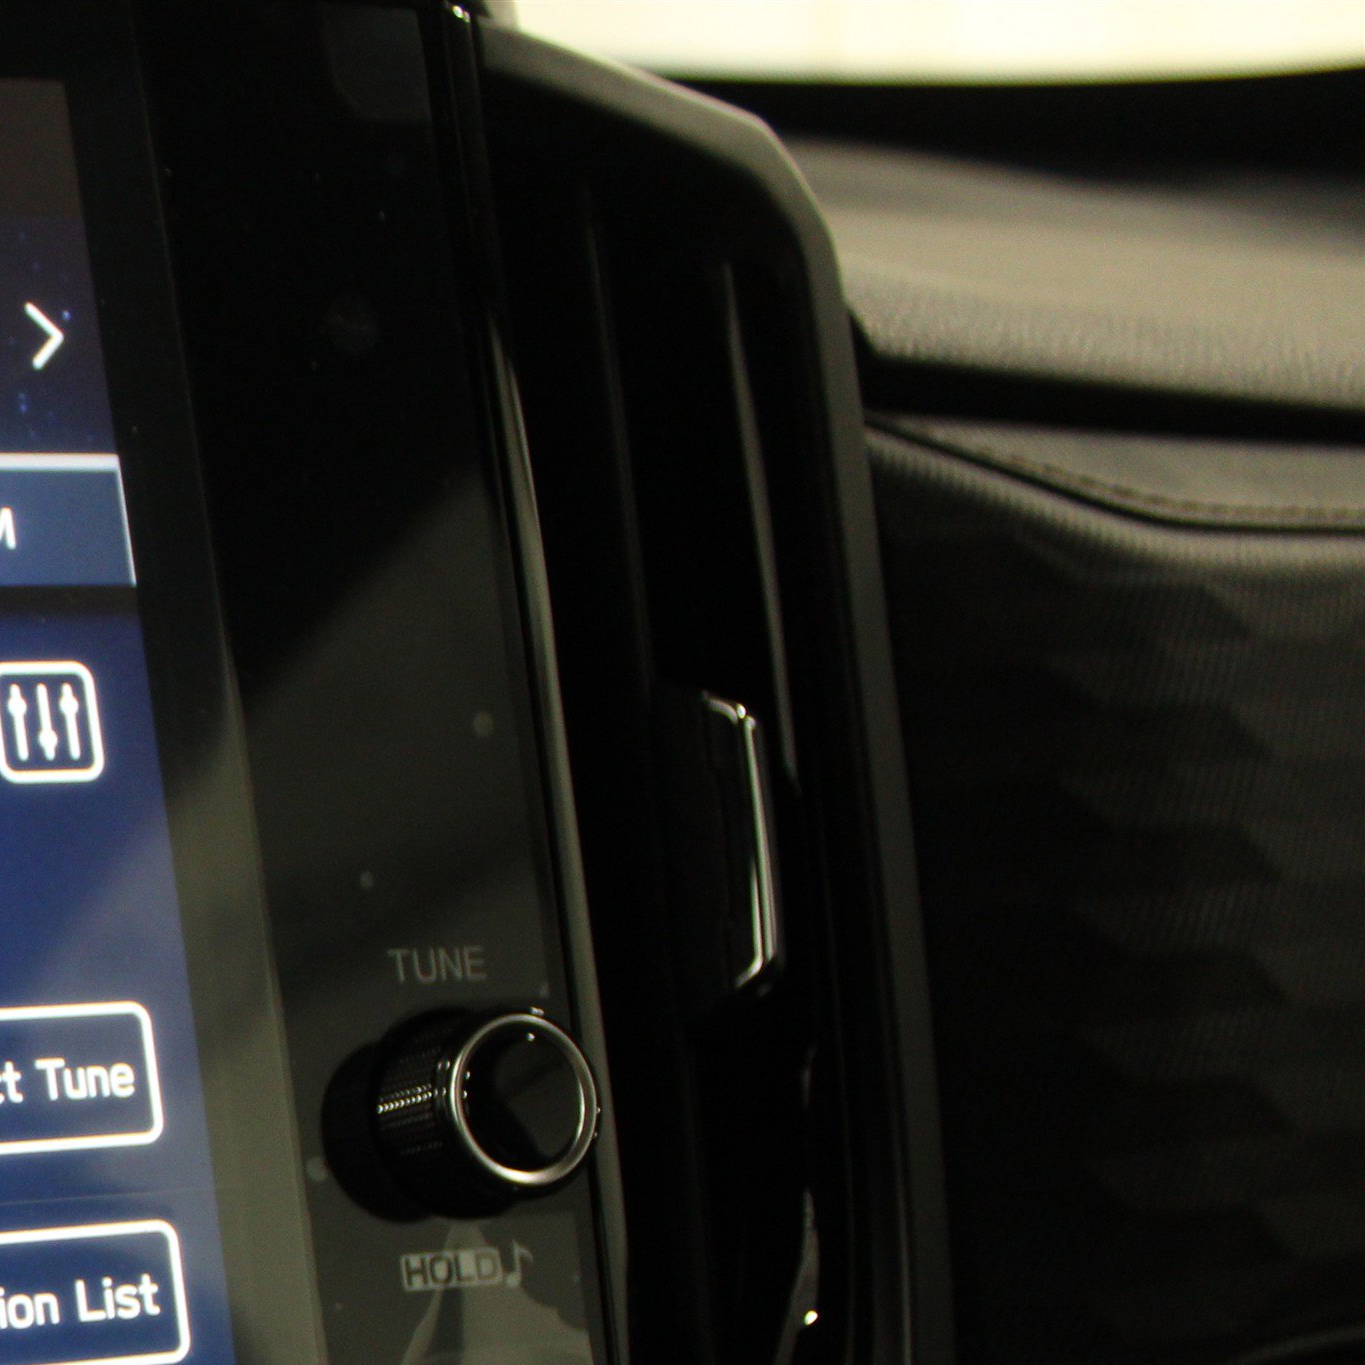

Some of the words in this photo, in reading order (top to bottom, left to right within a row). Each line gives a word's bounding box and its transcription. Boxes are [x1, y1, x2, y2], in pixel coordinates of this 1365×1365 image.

[392, 946, 485, 984] TUNE
[34, 1057, 136, 1101] Tune
[404, 1252, 498, 1287] HOLD
[74, 1273, 161, 1322] List
